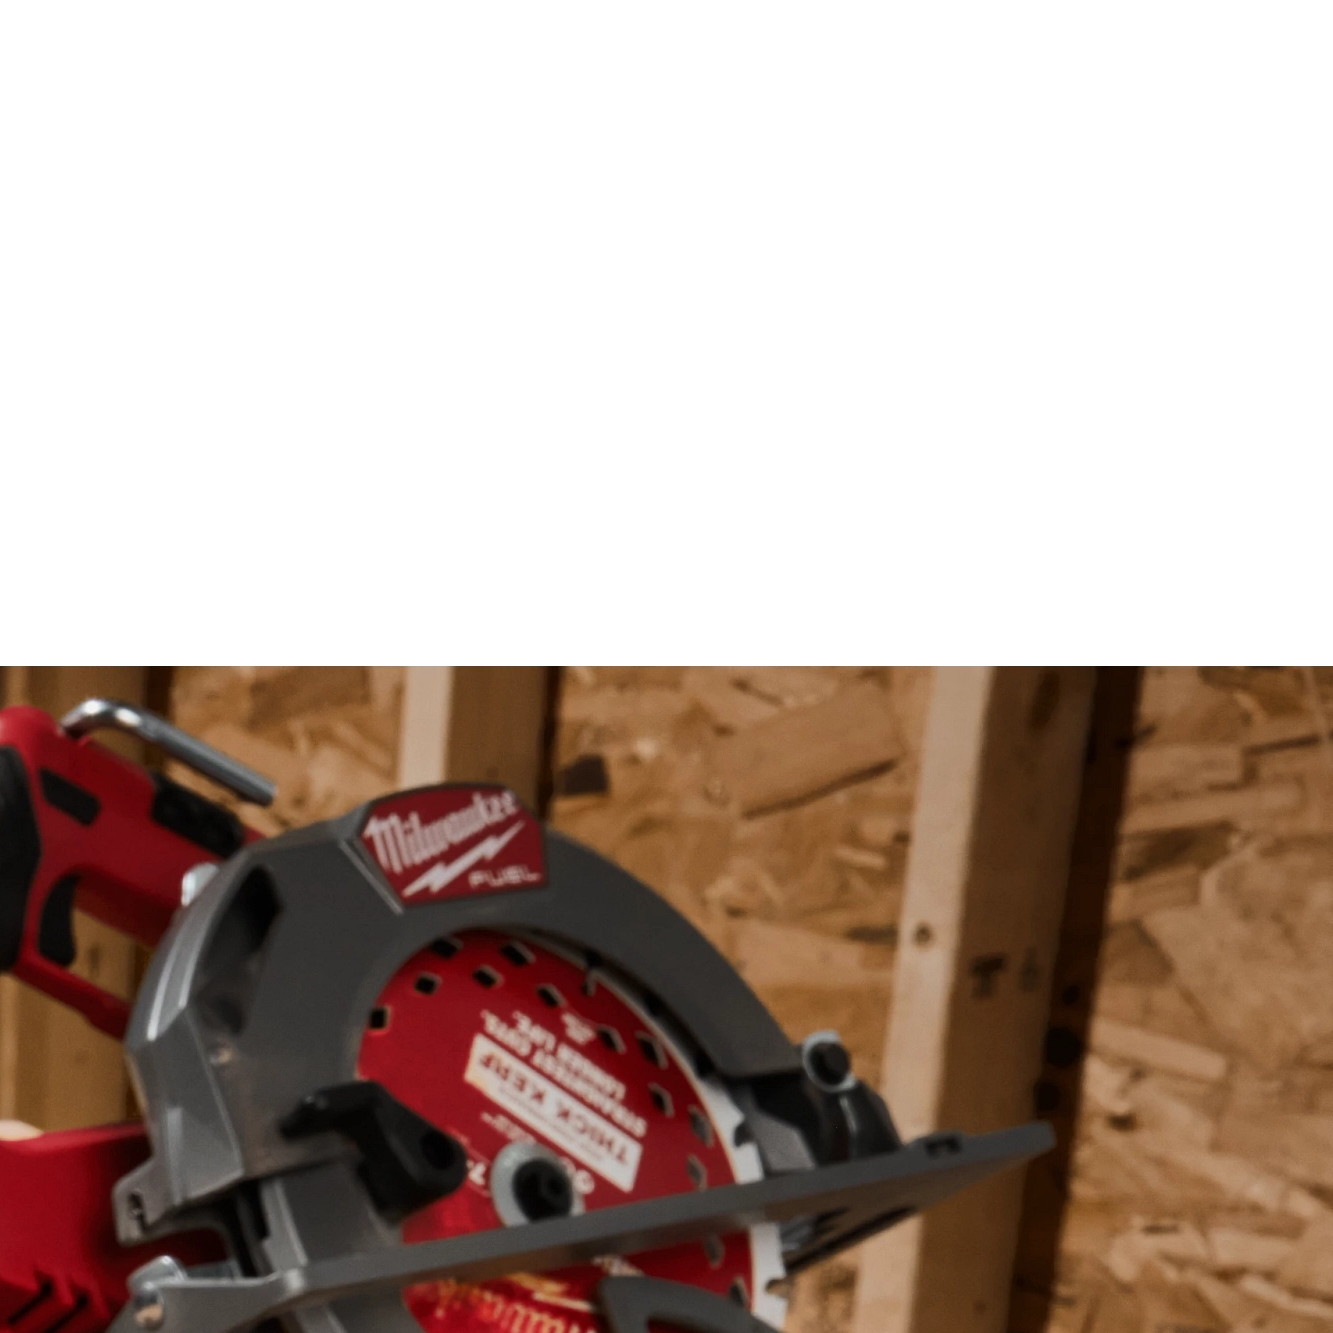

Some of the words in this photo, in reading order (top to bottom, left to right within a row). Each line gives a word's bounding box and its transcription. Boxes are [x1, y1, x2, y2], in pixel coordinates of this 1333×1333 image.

[363, 788, 522, 875] Milwaukee
[479, 1051, 547, 1105] KERF
[556, 1103, 631, 1166] THICK
